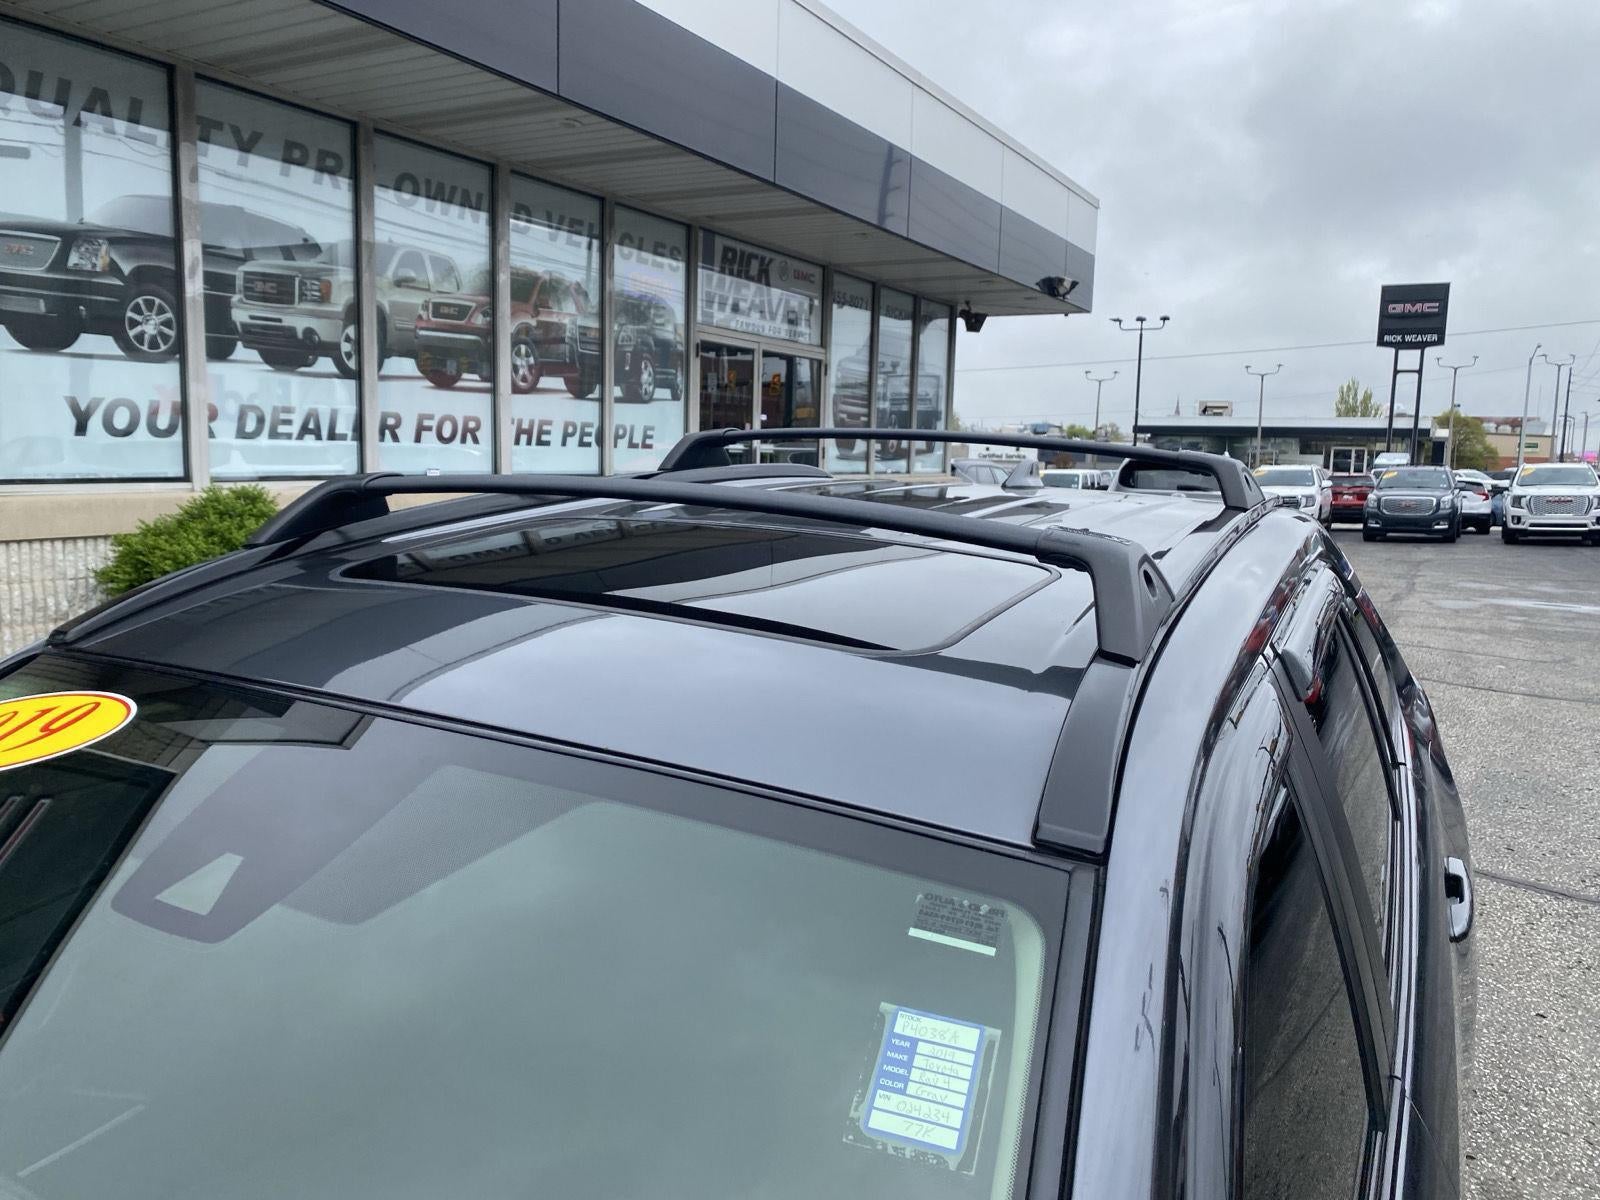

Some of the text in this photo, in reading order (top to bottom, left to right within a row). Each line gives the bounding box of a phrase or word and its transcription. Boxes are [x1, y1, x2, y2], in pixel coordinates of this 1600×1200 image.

[0, 61, 264, 168] UALTY
[719, 245, 774, 287] RICK
[1388, 302, 1440, 314] GMC
[1383, 333, 1438, 343] RICK WEAVER
[413, 412, 482, 445] FOR
[511, 416, 554, 447] HE
[891, 1038, 911, 1048] YEAR
[887, 1051, 909, 1061] MAKE
[883, 1064, 909, 1076] MODEL
[879, 1078, 905, 1090] COLOR
[878, 1093, 891, 1101] VIN
